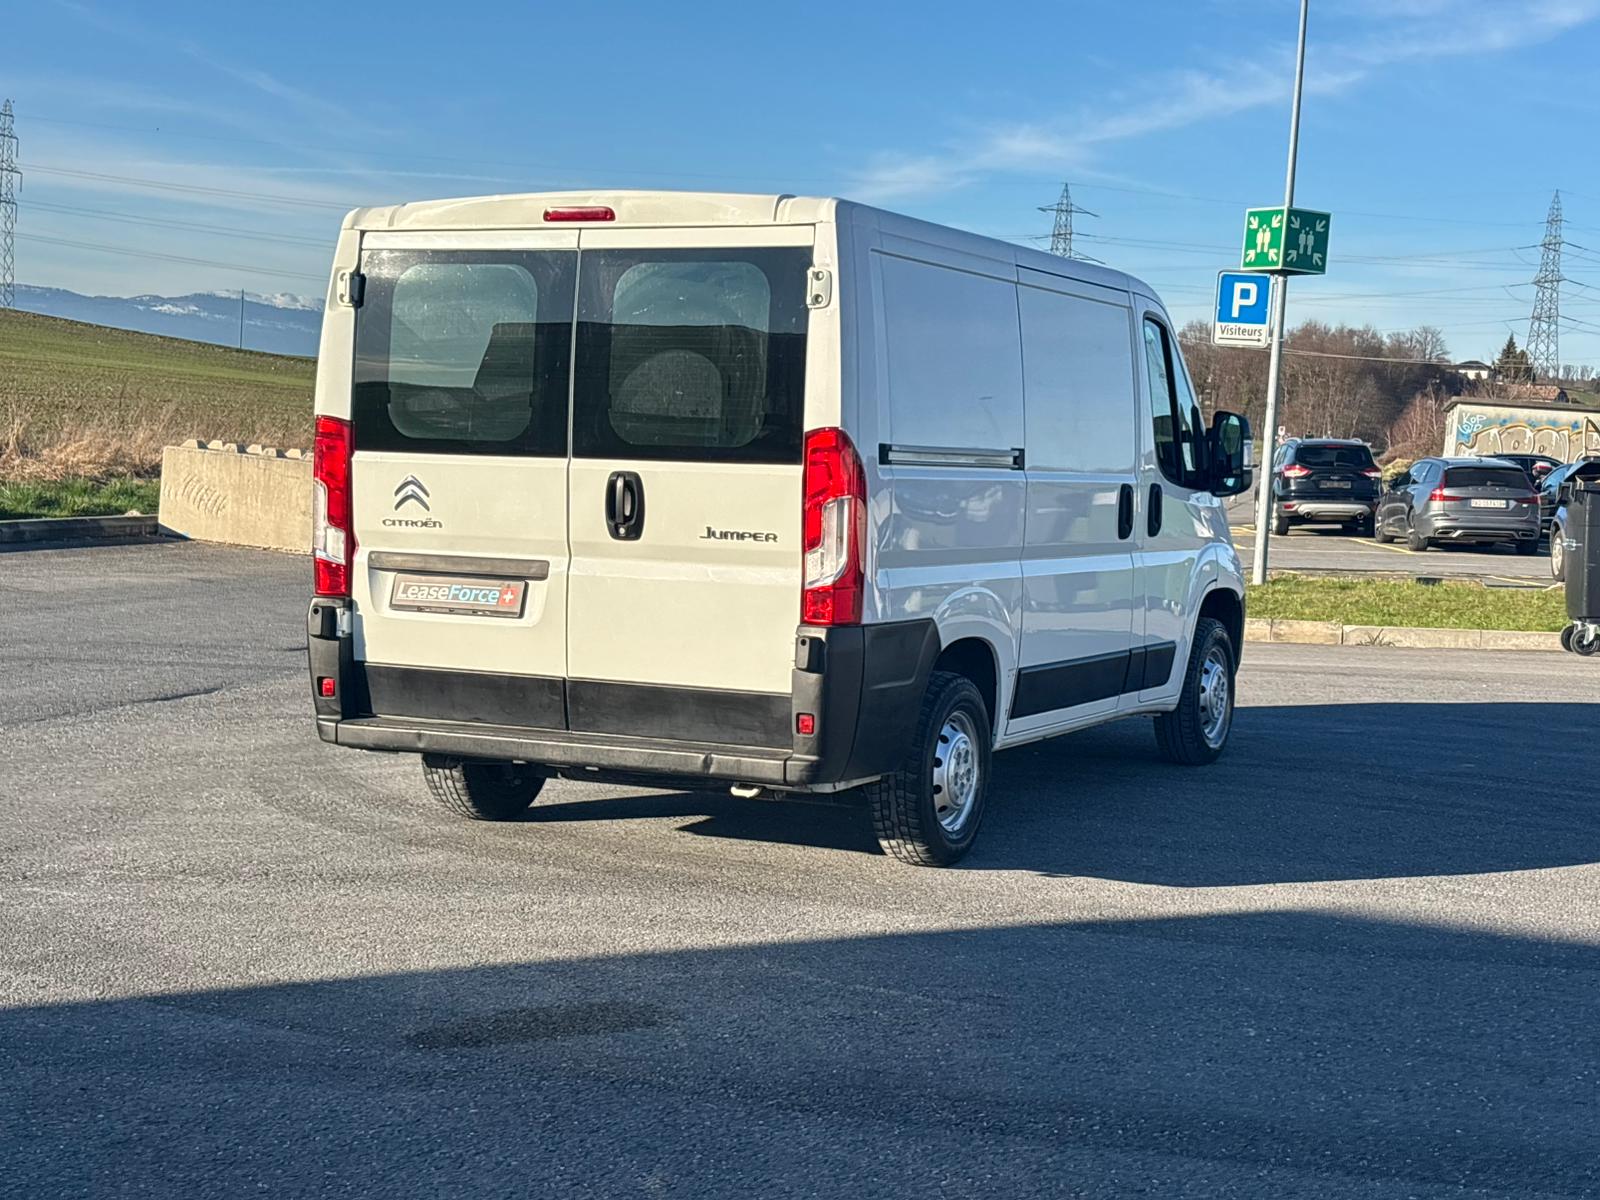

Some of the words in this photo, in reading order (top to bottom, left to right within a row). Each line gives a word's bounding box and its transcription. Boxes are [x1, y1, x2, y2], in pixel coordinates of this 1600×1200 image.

[1231, 282, 1258, 318] P
[1219, 325, 1263, 338] Visiteurs
[396, 581, 500, 605] LeaseForce
